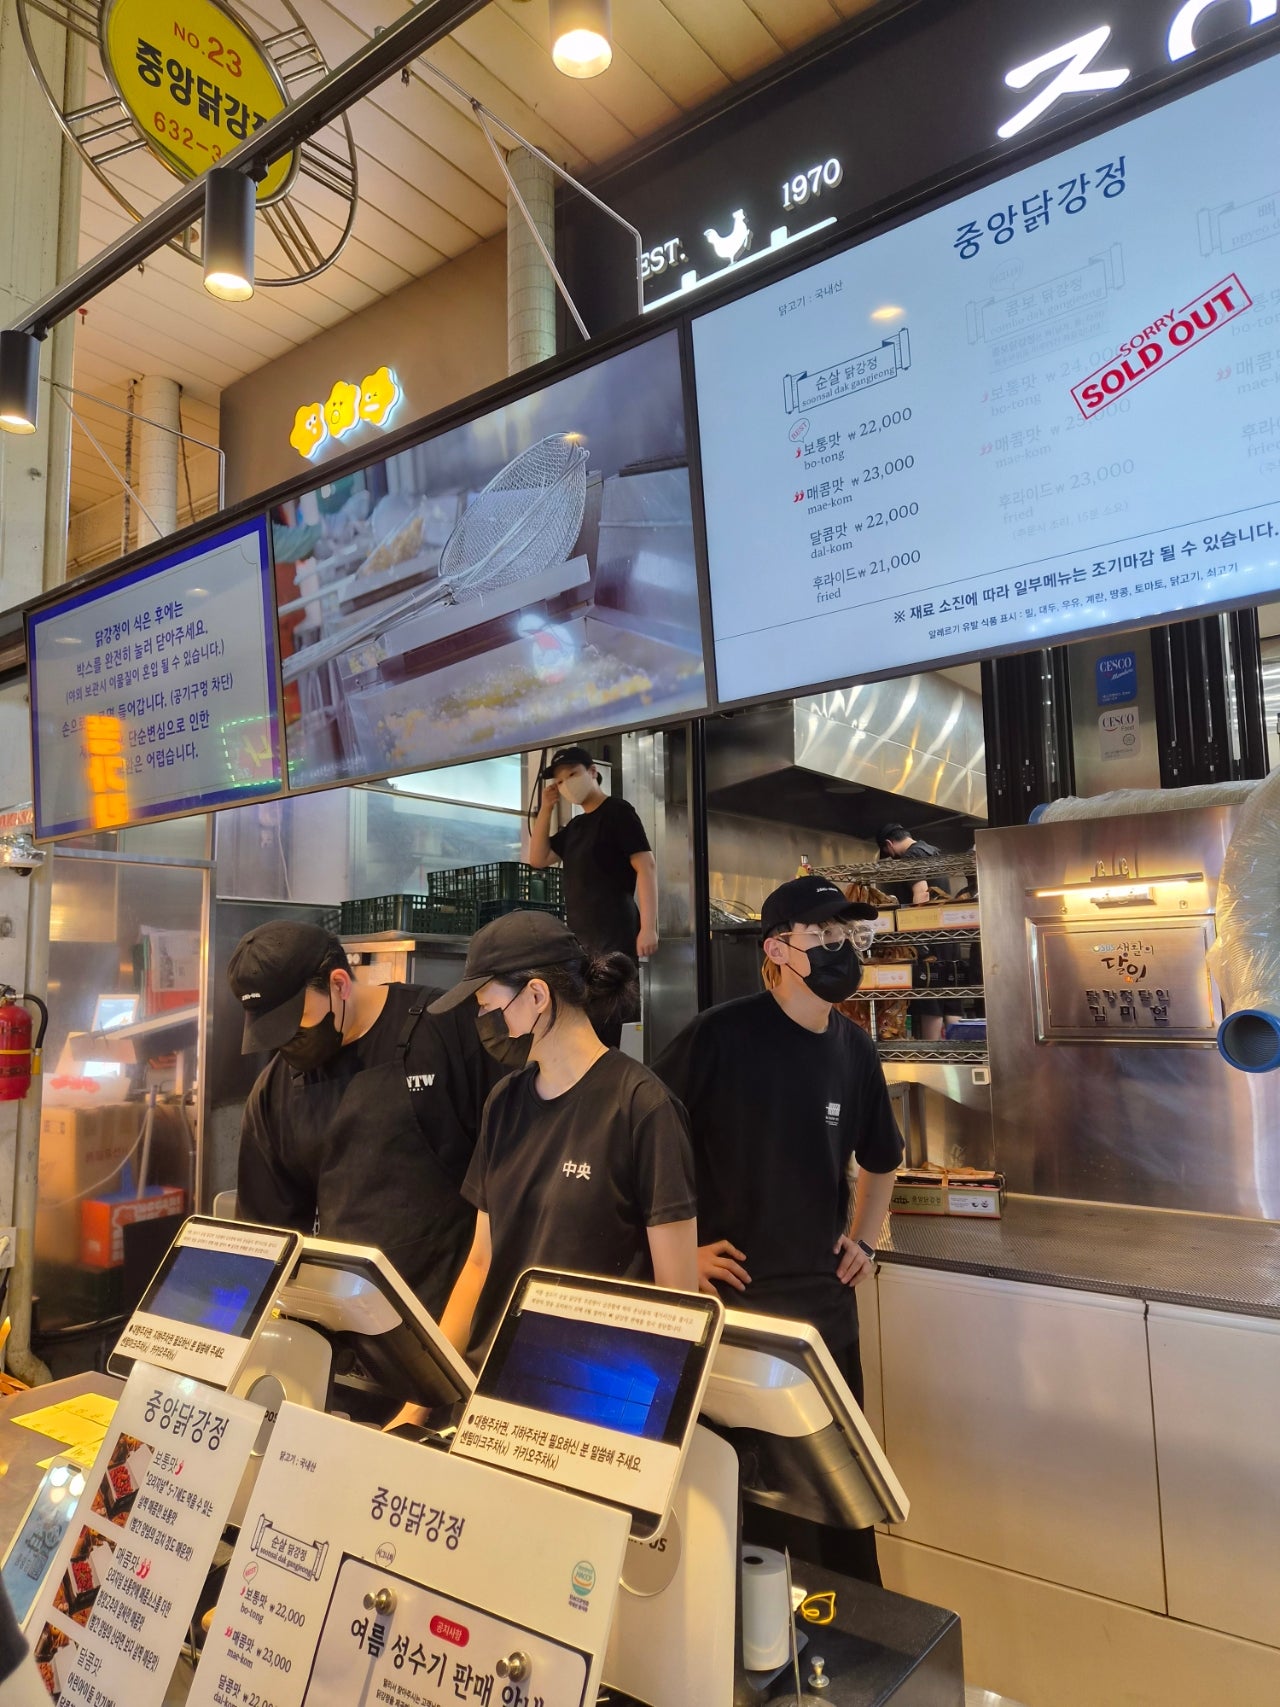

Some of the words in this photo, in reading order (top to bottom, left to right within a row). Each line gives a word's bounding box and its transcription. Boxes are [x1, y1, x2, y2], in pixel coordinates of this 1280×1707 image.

[782, 157, 843, 210] 1970
[953, 156, 1126, 260] 중앙닭강정
[778, 295, 806, 317] 닭고기
[814, 280, 843, 300] 국내산
[1119, 308, 1176, 356] SORRY
[1081, 342, 1163, 408] SOLD
[1168, 286, 1236, 347] OUT
[802, 388, 833, 407] soonsal
[834, 383, 849, 397] dak
[851, 366, 895, 391] gangjeong
[815, 371, 841, 391] 순살
[844, 356, 878, 379] 닭강정
[803, 432, 841, 457] 보통맛
[804, 450, 845, 470] bo-tong
[806, 477, 845, 501] 매콤맛
[807, 494, 853, 515] mae-kom
[810, 522, 848, 546] 달콤맛
[810, 540, 853, 559] dal-kom
[812, 567, 858, 590] 후라이드
[910, 603, 935, 620] 재료
[938, 591, 978, 613] 소진에
[982, 584, 1010, 603] 따라
[1014, 566, 1088, 597] 일부메뉴는
[1092, 549, 1155, 578] 조기마감
[1160, 544, 1176, 562] 될
[1181, 540, 1198, 557] 수
[1203, 521, 1280, 553] 있습니다.
[1134, 579, 1167, 594] 토마토,
[1169, 570, 1204, 587] 닭고기,
[816, 588, 841, 604] fried
[95, 619, 130, 648] 닭강정이
[133, 611, 152, 631] 식은
[155, 601, 184, 625] 후에는
[76, 656, 102, 678] 박스를
[105, 645, 131, 670] 완전히
[134, 637, 153, 660] 눌러
[156, 619, 209, 652] 닫아주세요.
[85, 678, 107, 698] 보관시
[109, 669, 140, 691] 이물질이
[142, 662, 159, 680] 혼입
[161, 658, 170, 673] 될
[172, 655, 181, 670] 수
[1099, 656, 1133, 674] CESCO
[117, 692, 168, 720] 들어갑니다.
[170, 680, 209, 707] (공기구멍
[211, 672, 234, 692] 차단)
[129, 718, 186, 748] 단순변심으로
[189, 709, 210, 732] 인한
[1102, 713, 1135, 728] CESCO
[146, 741, 200, 770] 어렵습니다.
[1101, 955, 1147, 983] 달인
[562, 1160, 592, 1181] 中央
[143, 1389, 230, 1451] 중앙닭강정
[473, 1414, 509, 1437] 대형주차권,
[511, 1424, 548, 1447] 지하주차권
[548, 1434, 579, 1455] 필요하신
[579, 1443, 590, 1458] 분
[590, 1445, 615, 1466] 말씀해
[153, 1450, 178, 1474] 보통맛
[371, 1486, 466, 1551] 중앙닭강정
[115, 1548, 141, 1574] 매콤맛
[271, 1535, 288, 1553] 순살
[287, 1543, 308, 1563] 닭강정
[244, 1587, 268, 1610] 보통맛
[240, 1603, 265, 1625] bo-tong
[231, 1630, 255, 1653] 매콤맛
[435, 1620, 462, 1642] 공지사항
[77, 1647, 103, 1677] 달콤맛
[351, 1617, 385, 1659] 여름
[391, 1634, 447, 1688] 성수기
[452, 1663, 495, 1707] 판매
[218, 1674, 242, 1699] 달콤맛
